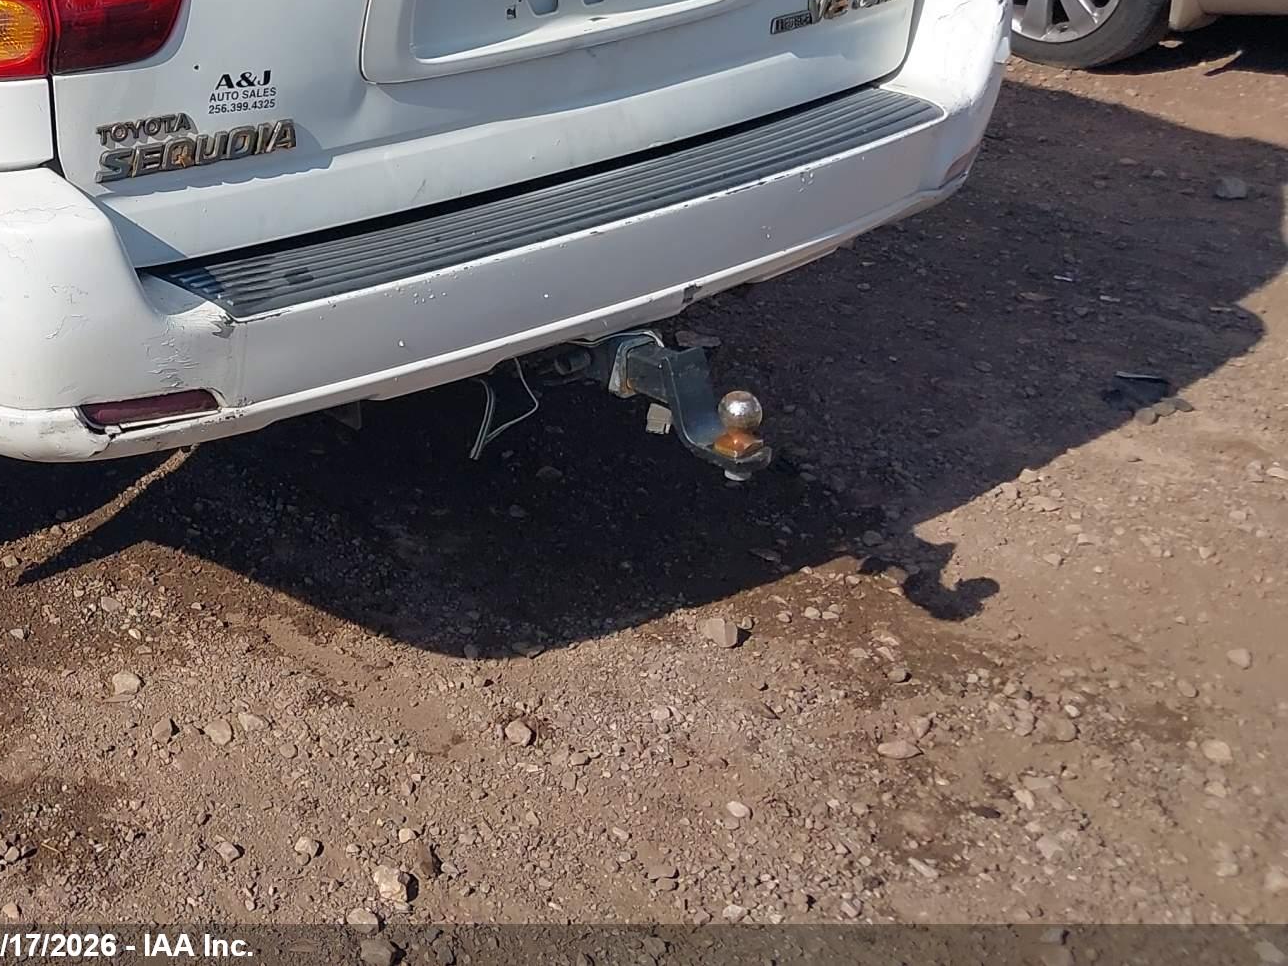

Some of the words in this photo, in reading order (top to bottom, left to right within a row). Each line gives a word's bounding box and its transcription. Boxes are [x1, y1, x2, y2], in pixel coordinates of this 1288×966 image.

[215, 70, 271, 90] A&J
[209, 89, 239, 102] AUTO
[242, 86, 277, 100] SALES
[208, 99, 276, 114] 256.399.4325
[96, 113, 191, 145] TOYOTA
[95, 119, 297, 183] SEQUOIA
